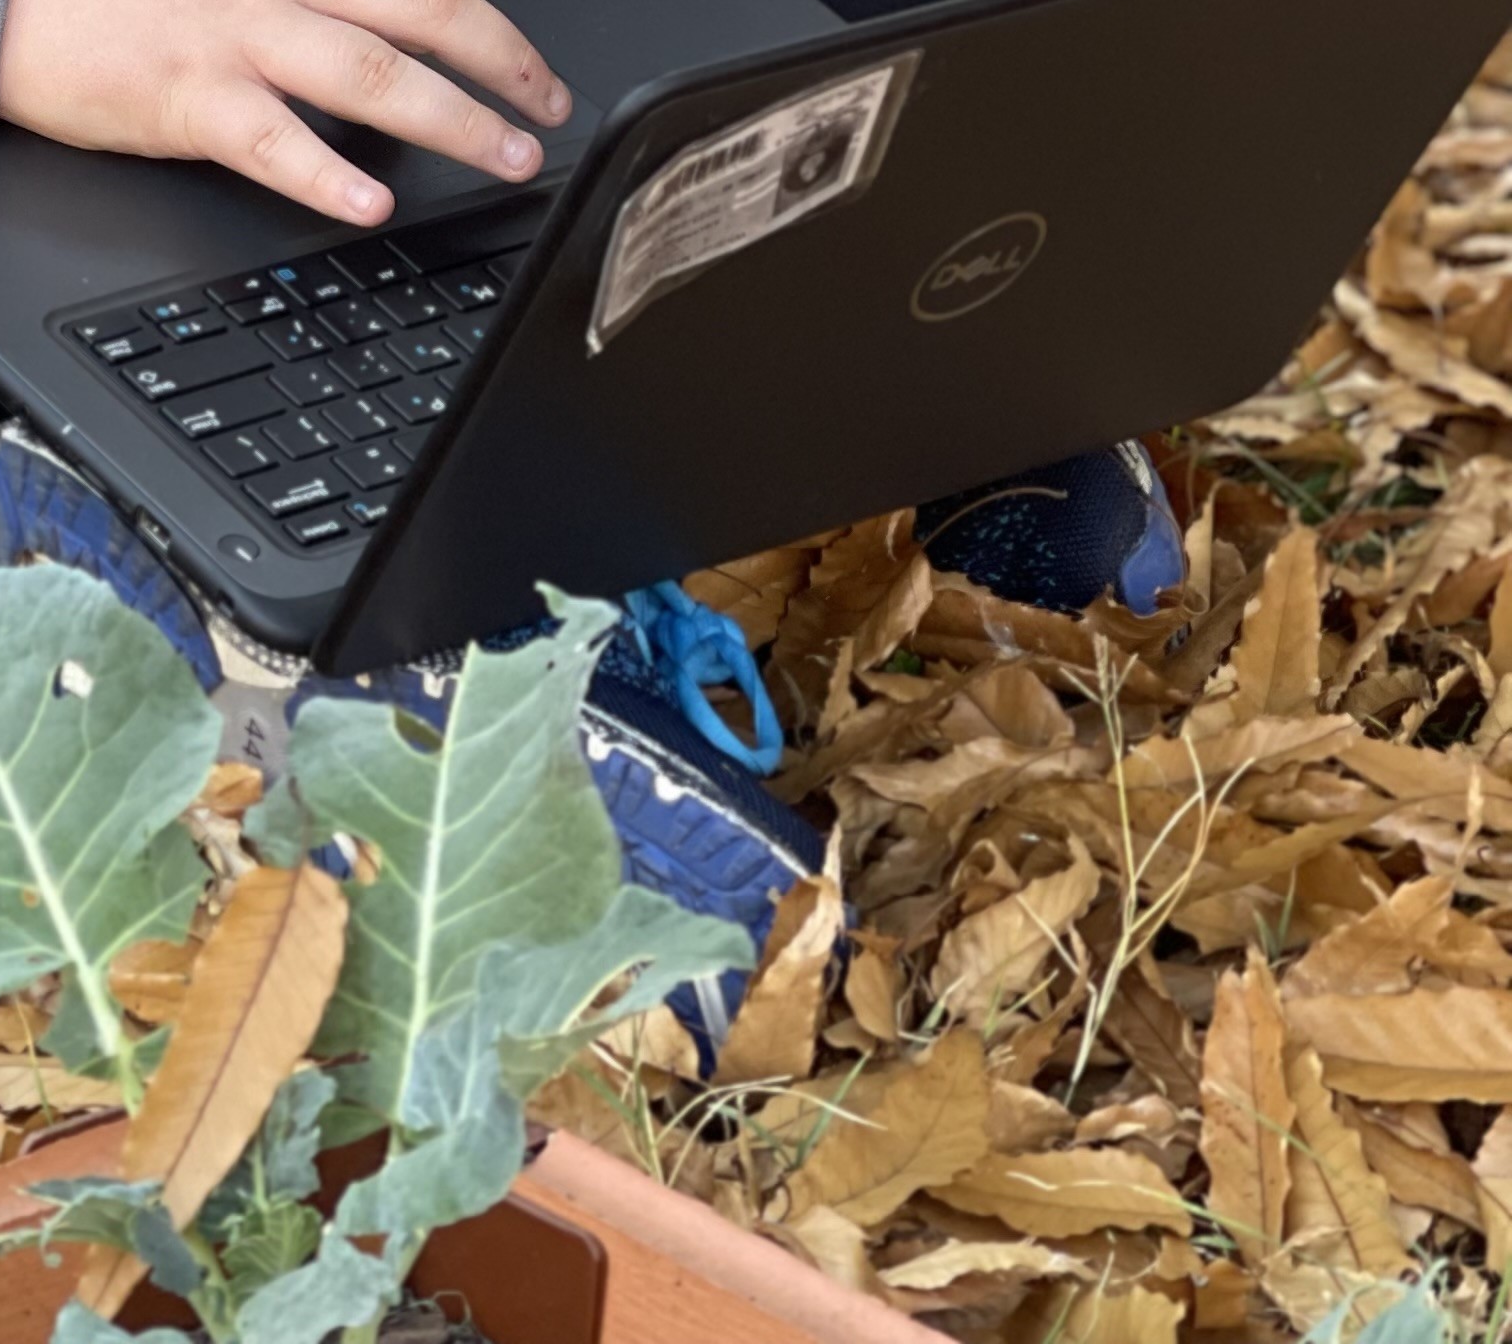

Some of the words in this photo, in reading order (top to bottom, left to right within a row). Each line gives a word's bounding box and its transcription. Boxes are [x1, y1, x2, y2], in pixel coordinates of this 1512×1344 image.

[930, 244, 1022, 291] DELL
[190, 418, 221, 431] Enter
[271, 487, 330, 509] Backspace
[301, 519, 339, 537] Delete
[242, 716, 265, 762] 44
